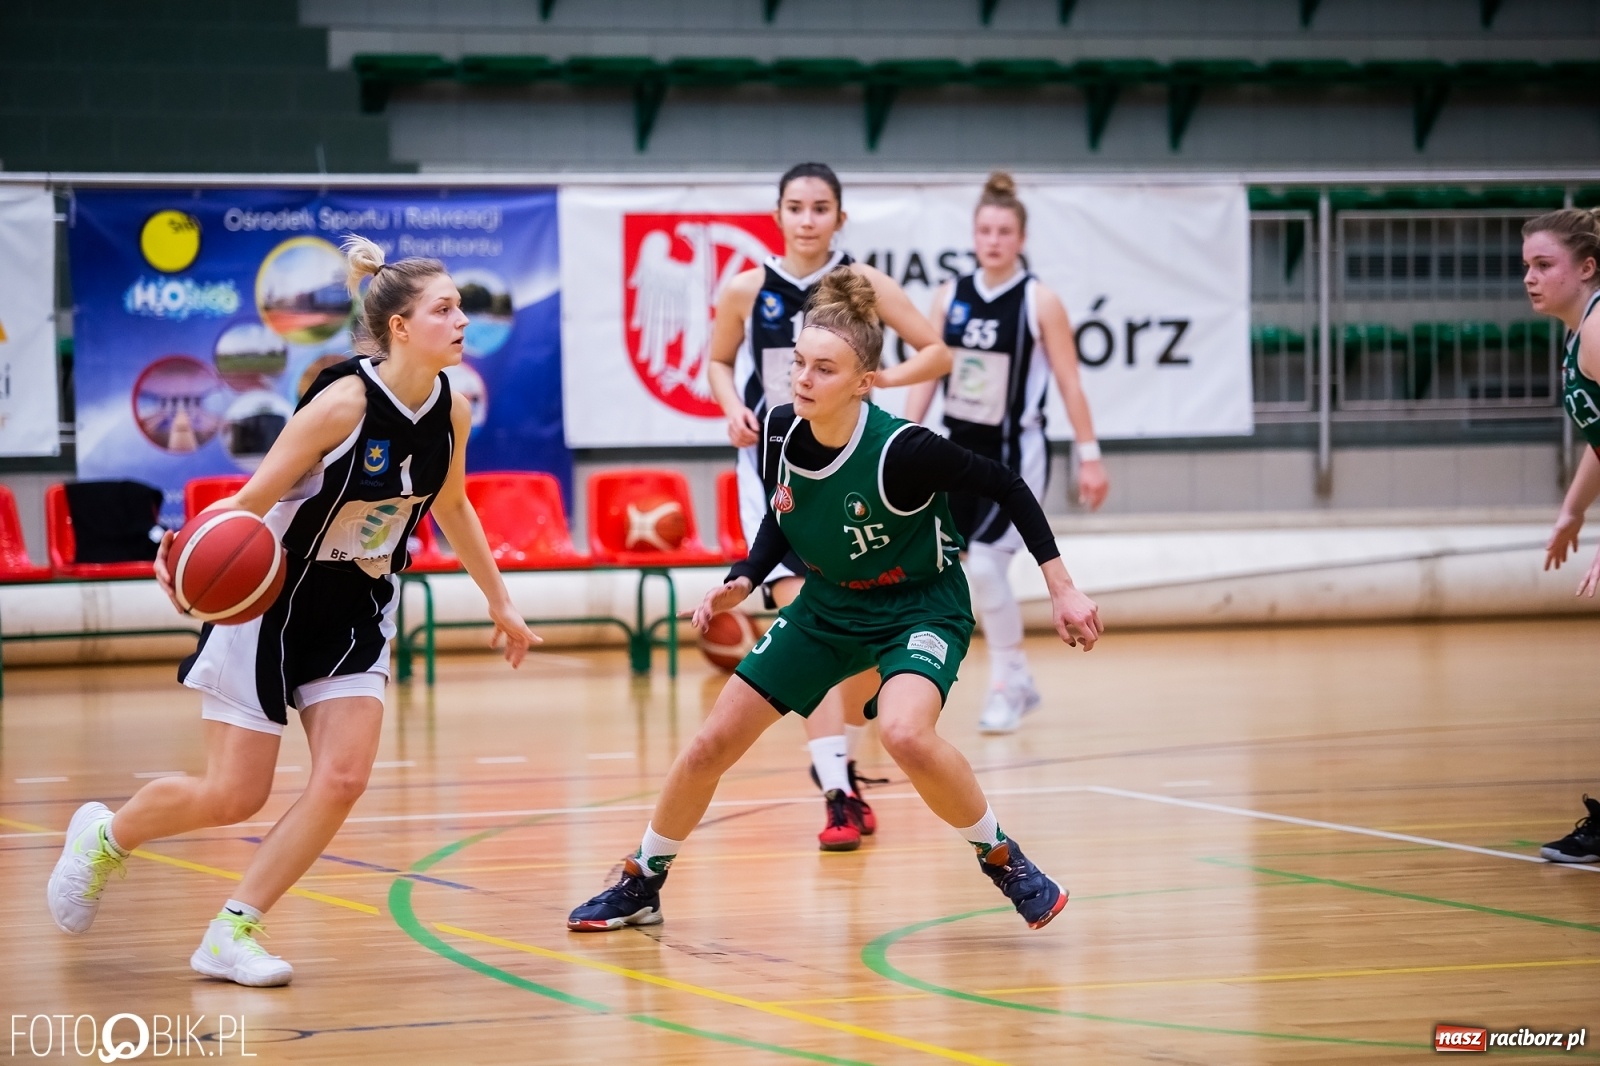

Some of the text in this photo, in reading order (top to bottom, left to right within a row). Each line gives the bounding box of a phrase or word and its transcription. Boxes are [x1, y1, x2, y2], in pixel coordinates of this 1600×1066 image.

[866, 249, 1028, 287] IAS
[962, 318, 999, 350] 55
[1565, 388, 1600, 428] 23
[400, 454, 413, 495] 1
[330, 548, 348, 561] BE
[843, 523, 890, 560] 35
